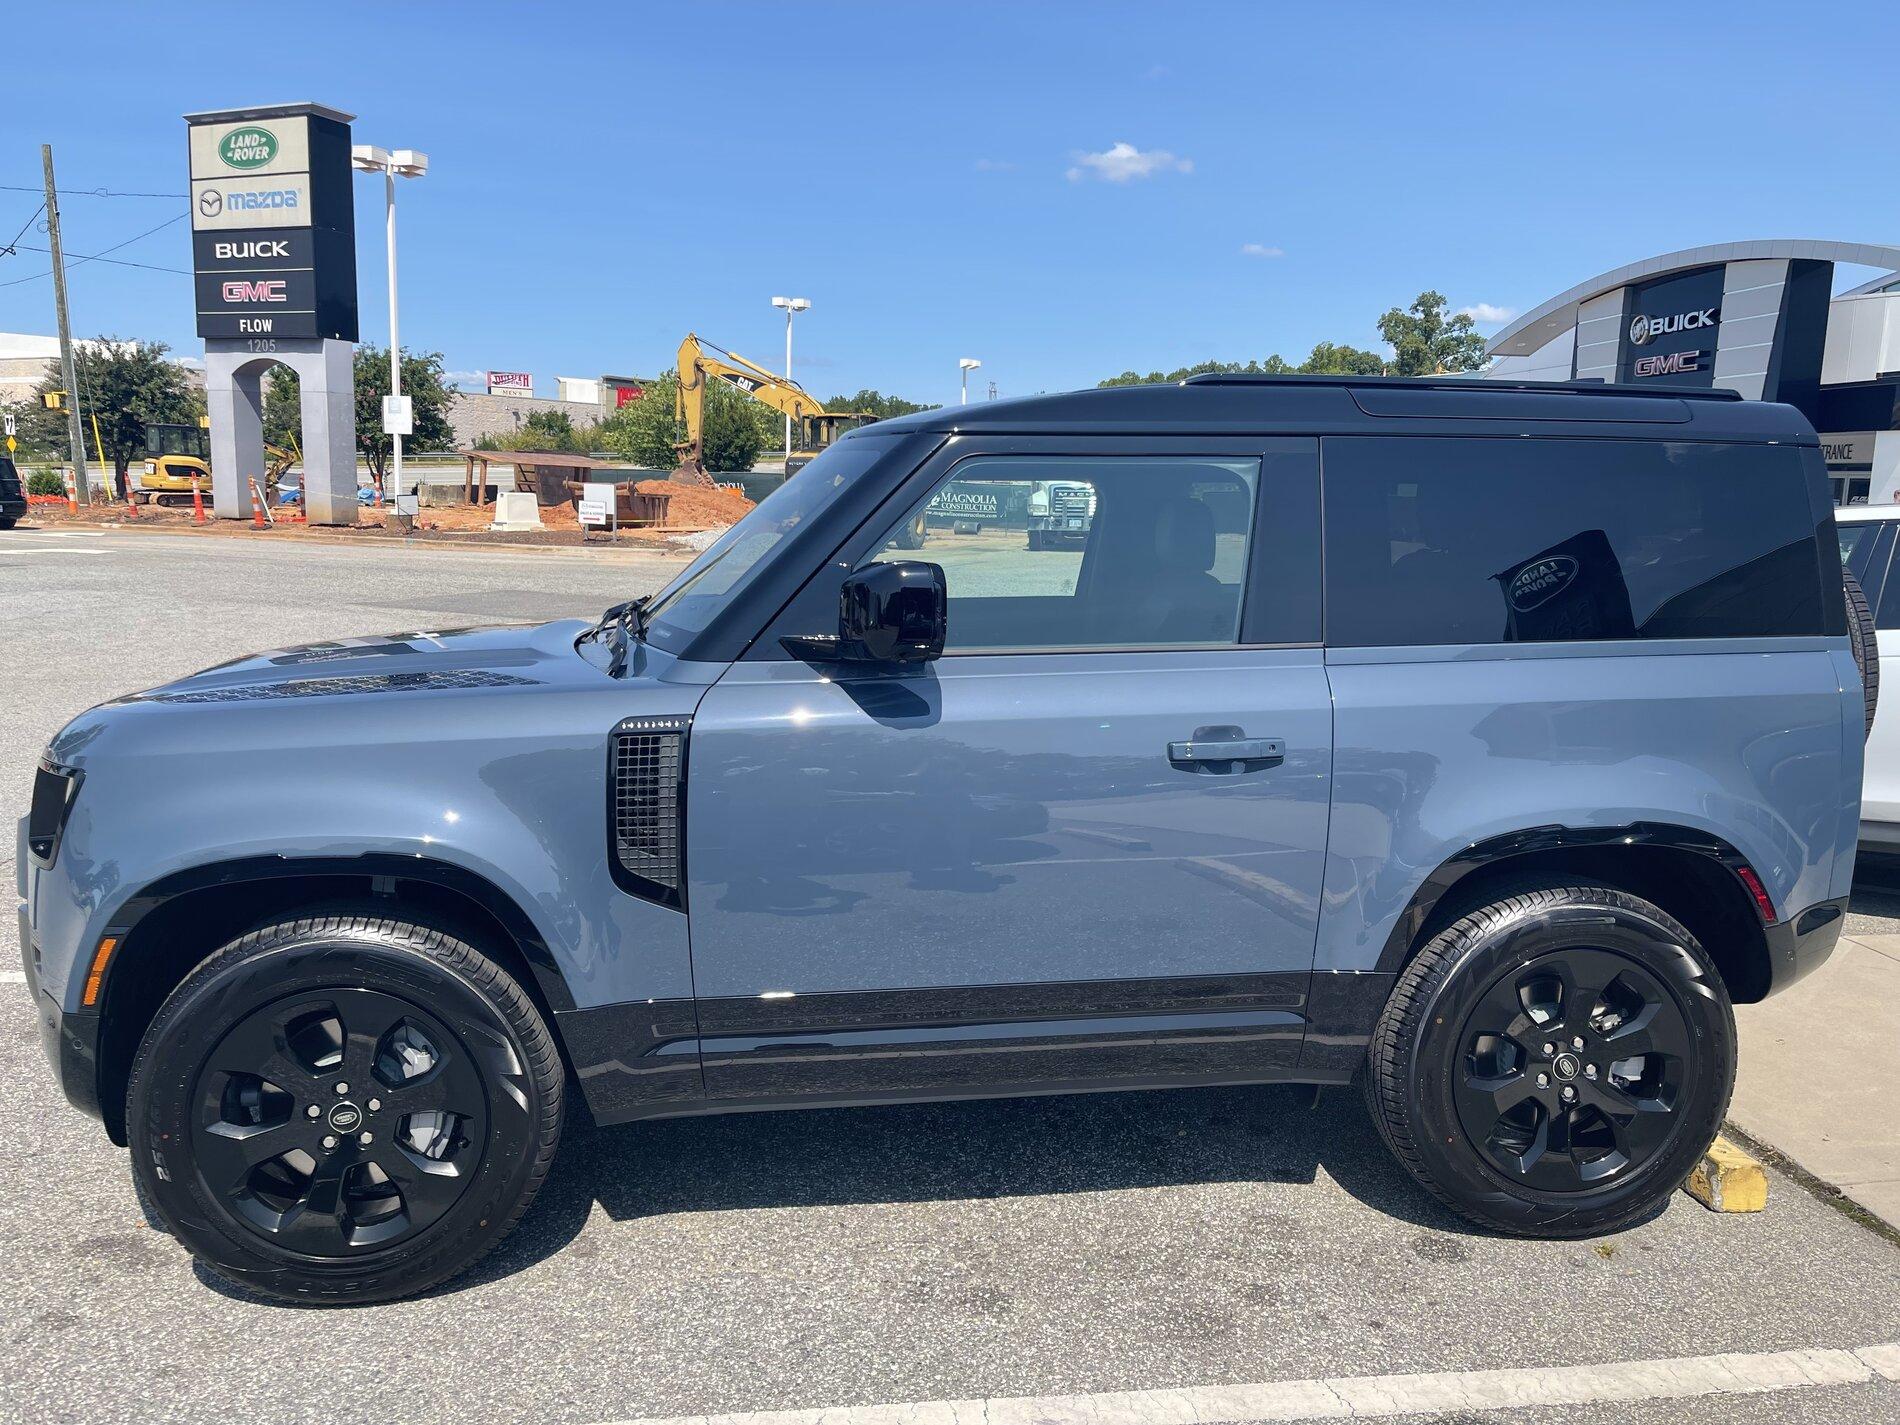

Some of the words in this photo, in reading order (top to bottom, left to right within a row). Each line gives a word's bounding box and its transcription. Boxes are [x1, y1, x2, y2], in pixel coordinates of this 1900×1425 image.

[215, 240, 290, 259] BUICK
[222, 280, 287, 302] GMC
[239, 318, 273, 333] FLOW
[1649, 308, 1715, 336] BUICK
[247, 338, 276, 353] 1205
[1634, 350, 1700, 377] GMC
[737, 376, 754, 392] CAT
[1822, 443, 1853, 460] TRANCE
[941, 491, 998, 505] MAGNOLIA
[941, 503, 997, 511] CONSTRUCTION
